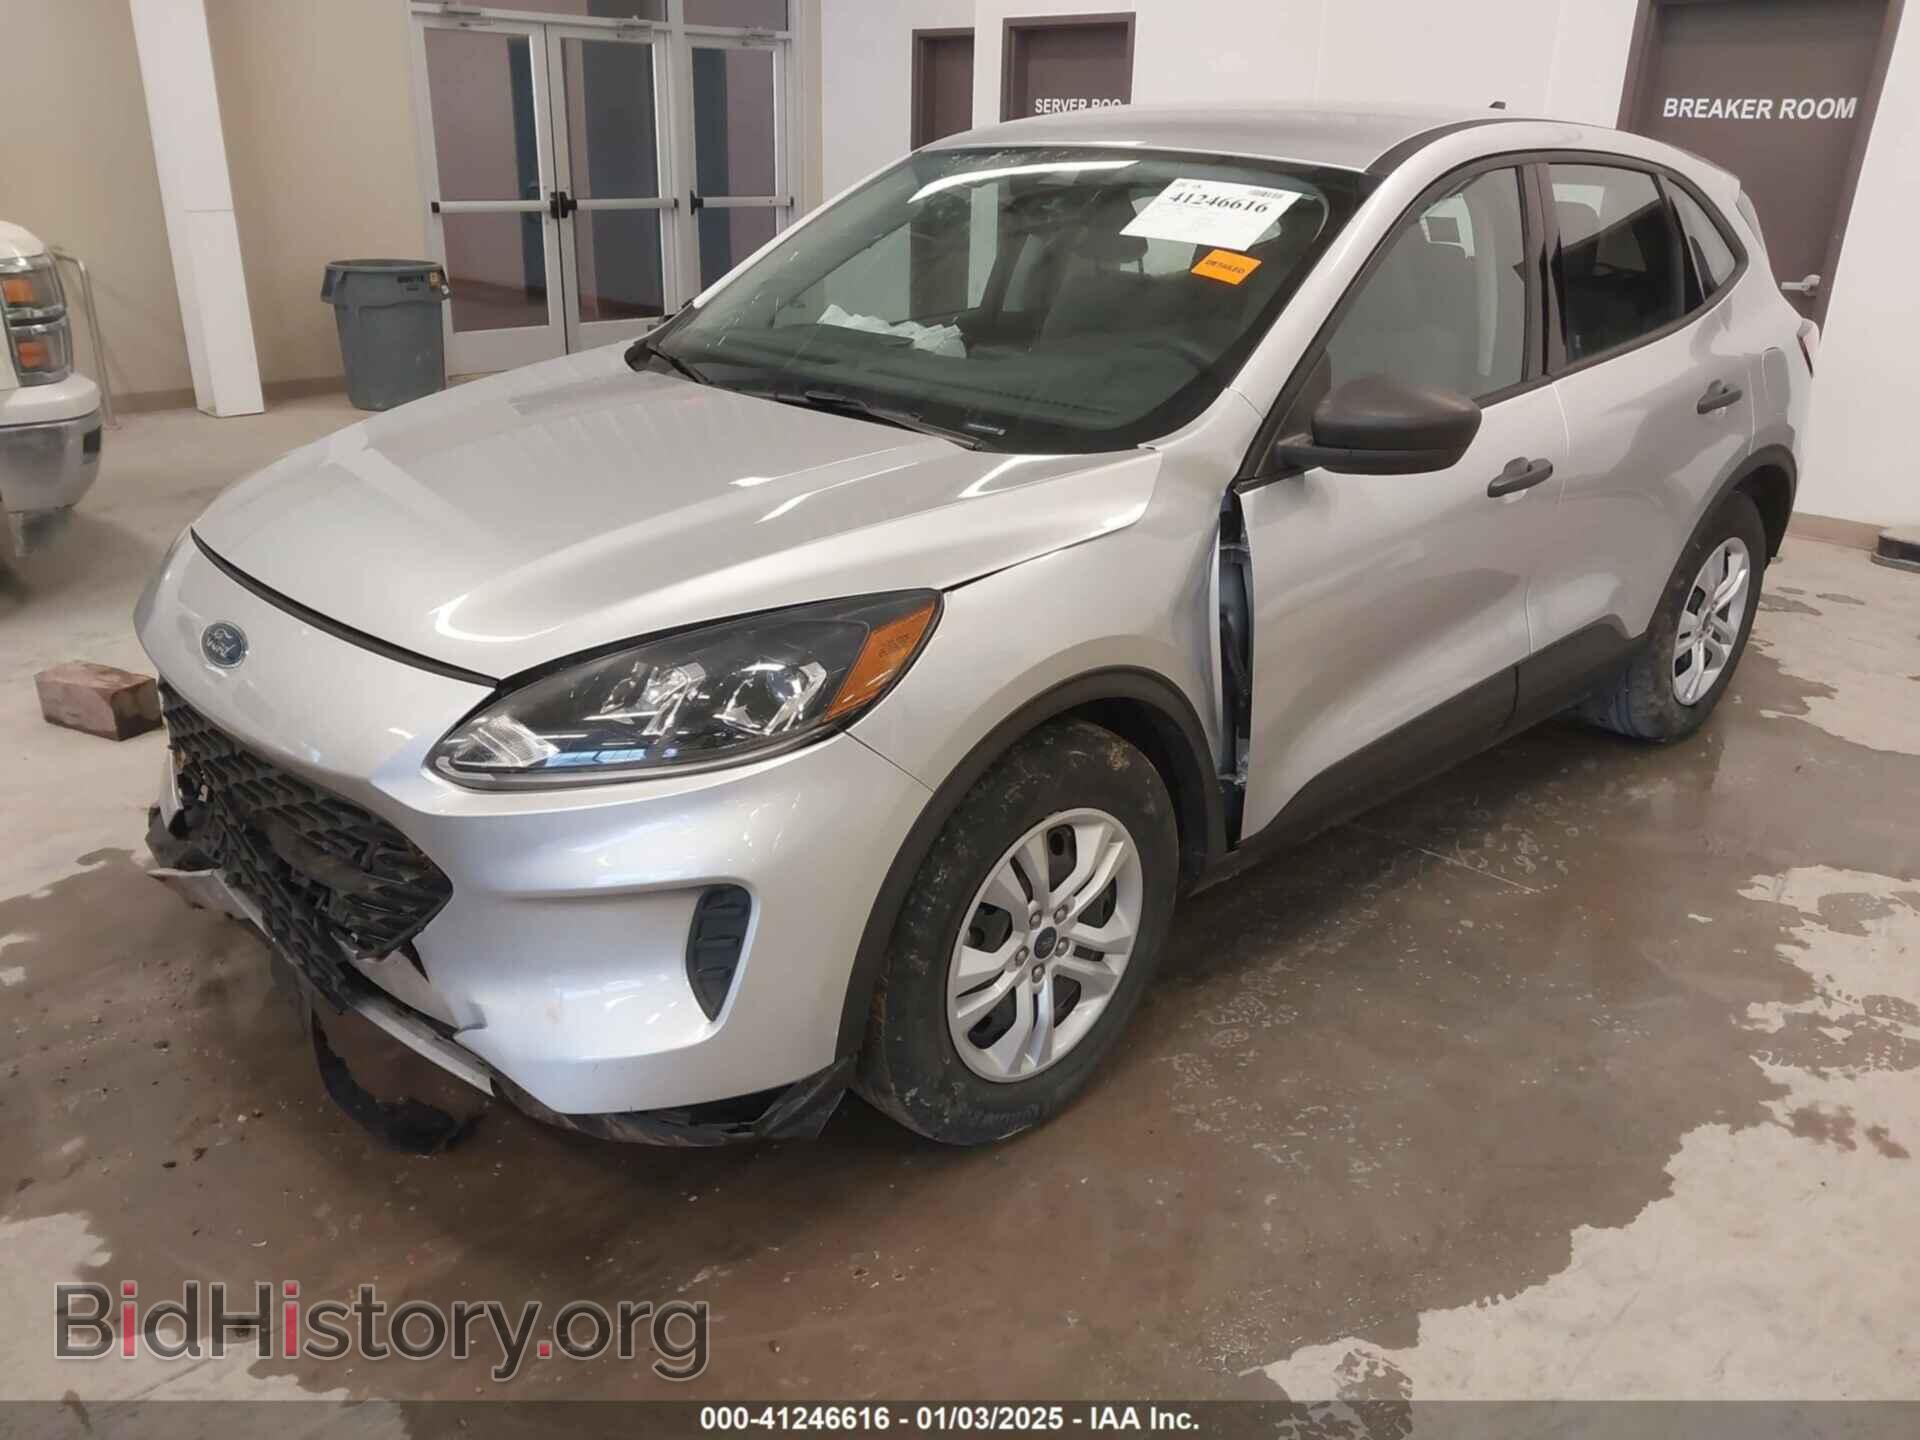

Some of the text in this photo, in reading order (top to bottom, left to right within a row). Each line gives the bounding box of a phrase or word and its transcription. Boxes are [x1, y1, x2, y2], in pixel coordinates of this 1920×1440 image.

[1034, 98, 1088, 113] SERVER
[1663, 97, 1858, 120] BREAKER ROOM
[1169, 191, 1268, 214] 41246616
